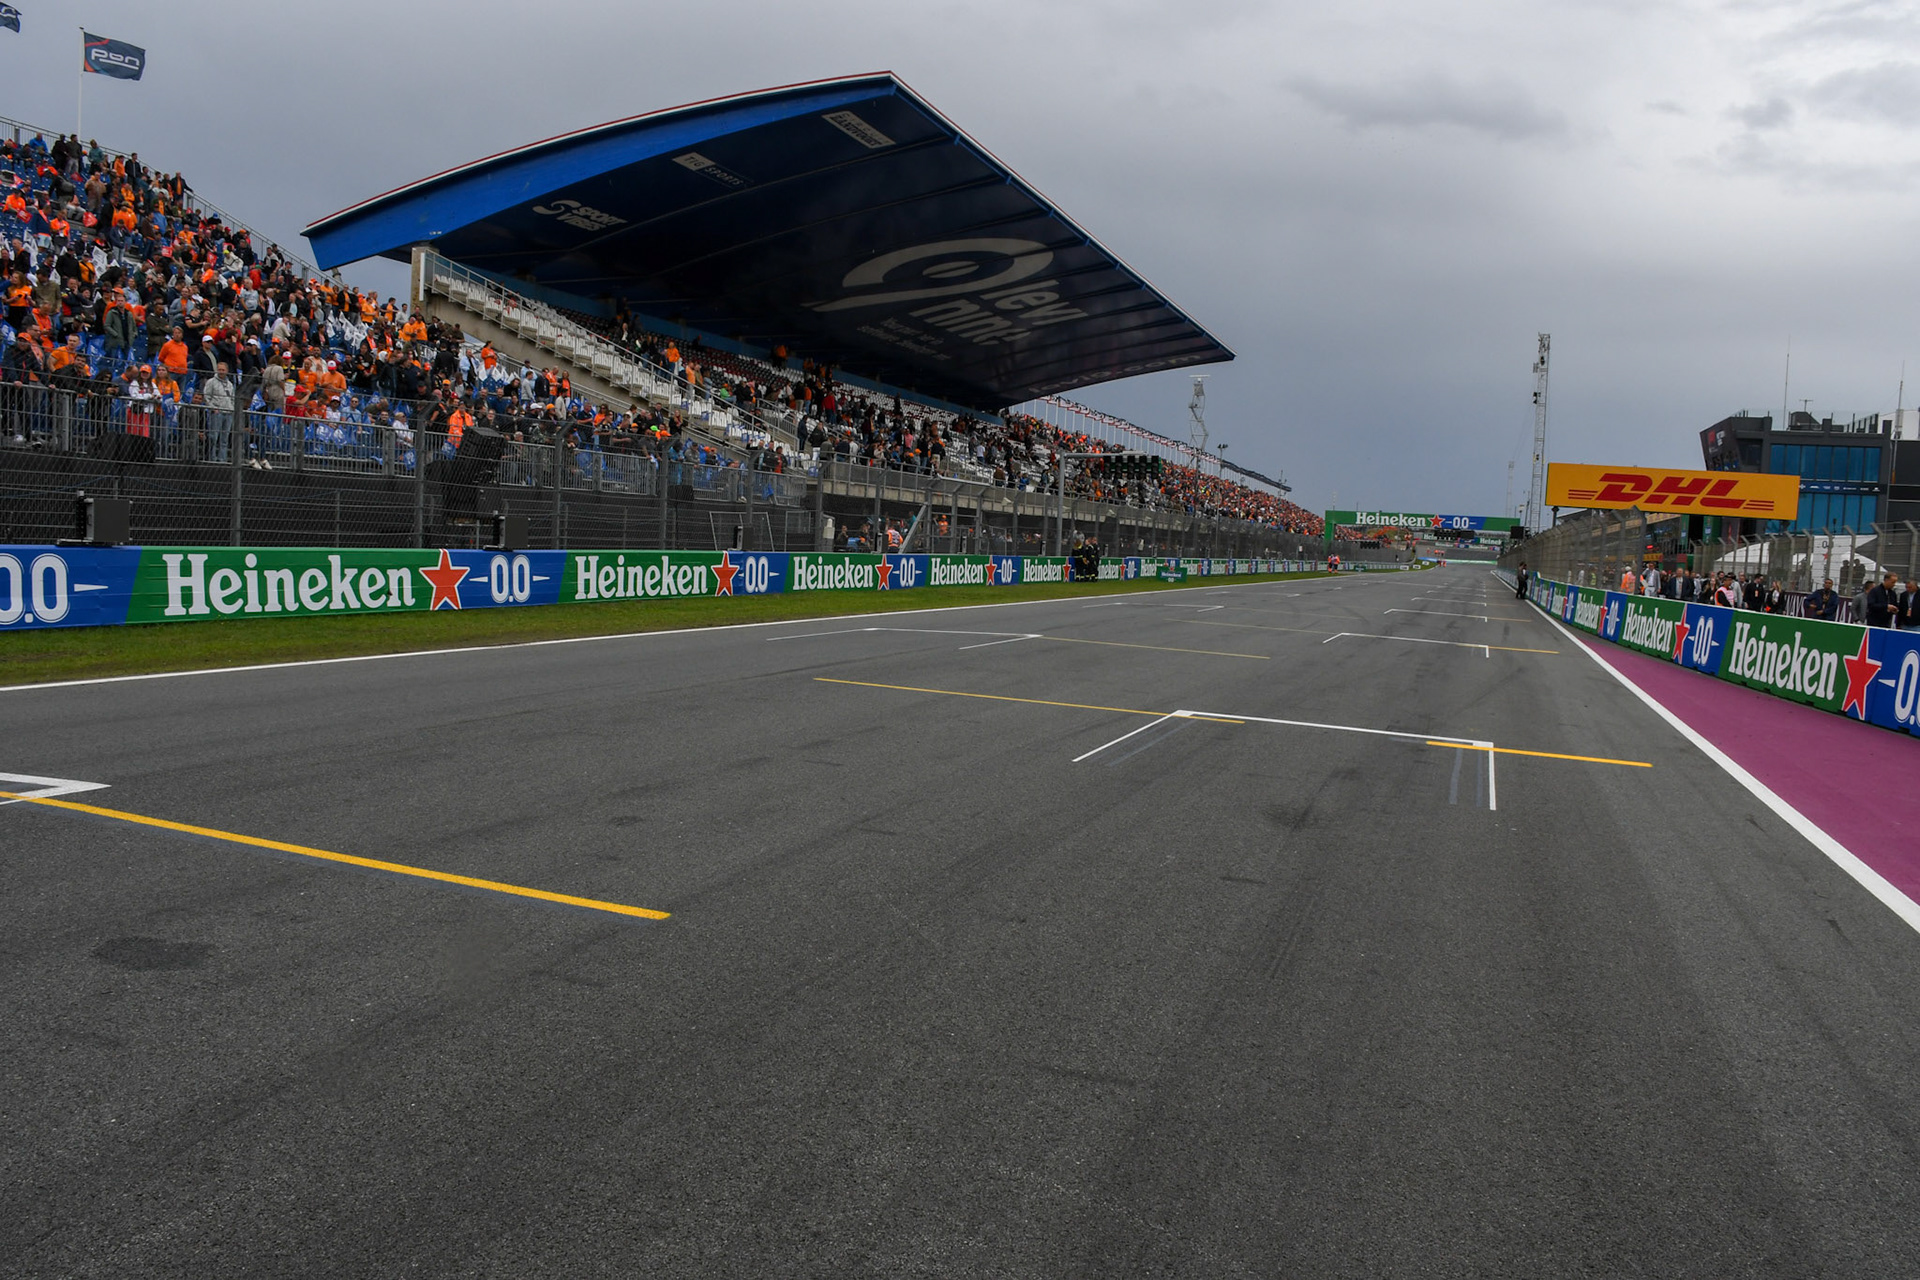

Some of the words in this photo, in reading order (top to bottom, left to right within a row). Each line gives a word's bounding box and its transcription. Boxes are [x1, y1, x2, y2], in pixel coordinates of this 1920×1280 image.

[704, 167, 745, 185] SPORTS
[571, 206, 628, 226] SPORT
[1595, 473, 1746, 509] DHL
[1356, 511, 1426, 527] Heineken
[1452, 516, 1470, 529] 0.0
[162, 553, 416, 617] Heineken
[490, 555, 531, 603] 0.0
[575, 555, 708, 600] Heineken
[745, 556, 769, 593] 0.0
[793, 556, 874, 591] Heineken
[900, 557, 916, 588] 0.0
[930, 557, 984, 586] Heineken
[1023, 559, 1062, 582] Heineken
[1574, 592, 1600, 630] Heineken
[1622, 602, 1673, 653] Heineken
[1692, 616, 1714, 666] 0.0
[1728, 621, 1838, 700] Heineken
[1894, 650, 1920, 727] 0.
